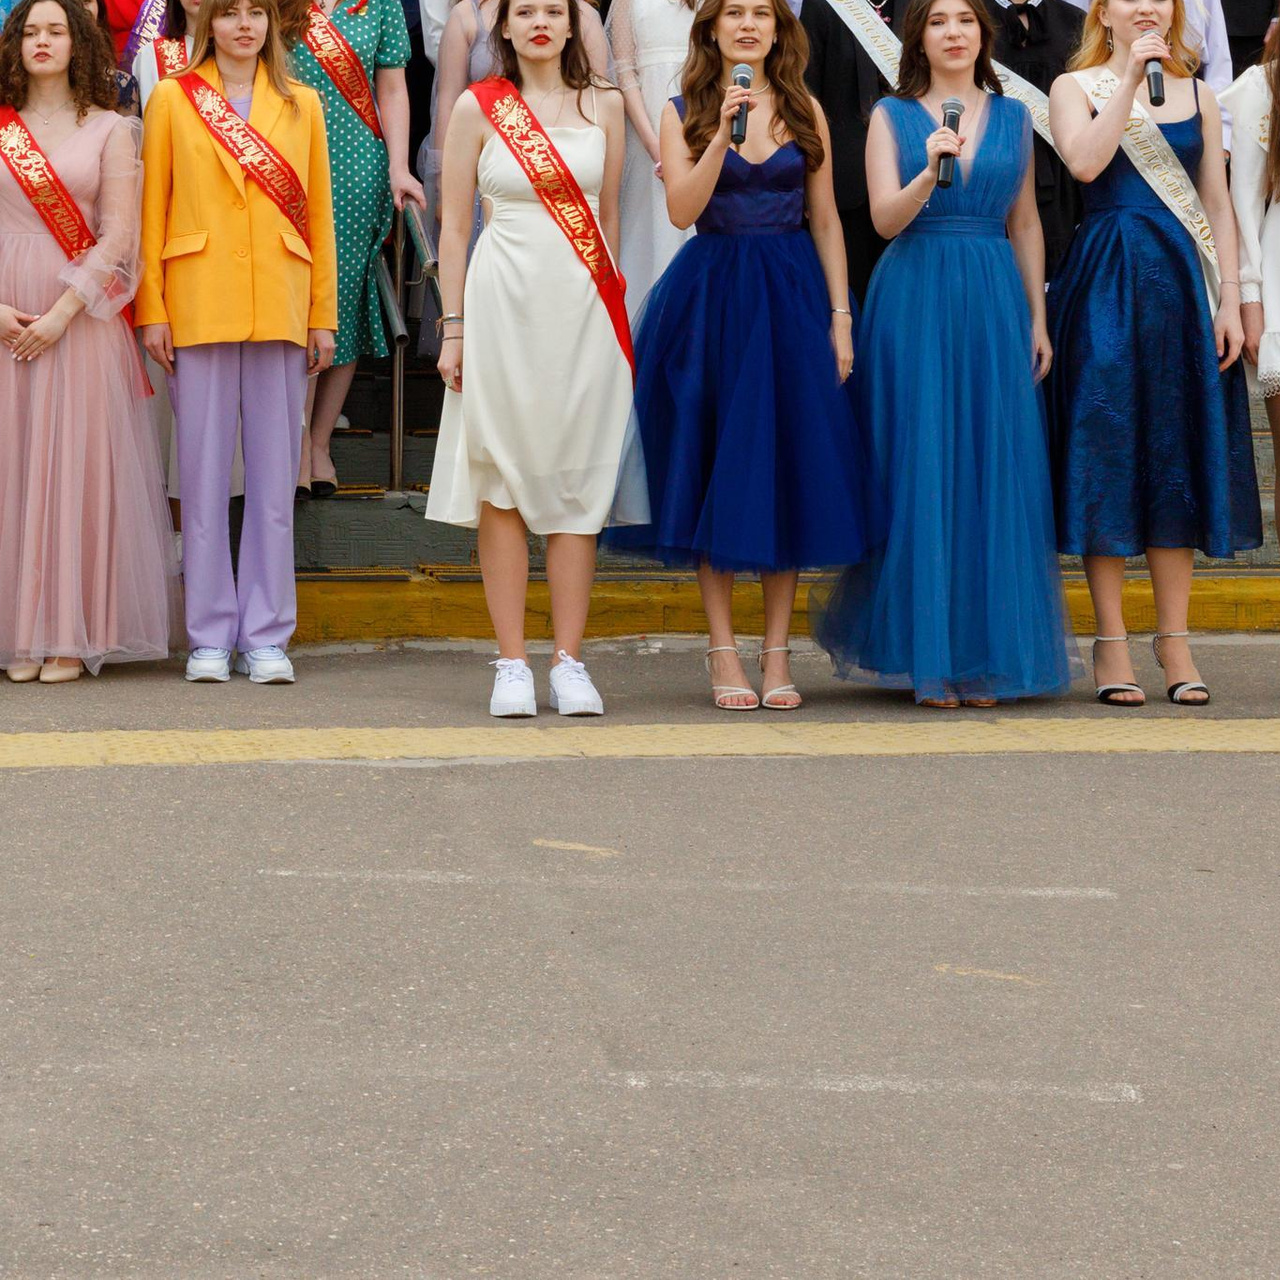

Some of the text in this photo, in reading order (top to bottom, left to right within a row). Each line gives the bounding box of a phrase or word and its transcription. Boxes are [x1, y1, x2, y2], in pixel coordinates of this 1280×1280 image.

[212, 111, 297, 201] Выпускник
[513, 130, 586, 238] Выпускник
[1188, 213, 1218, 262] 202
